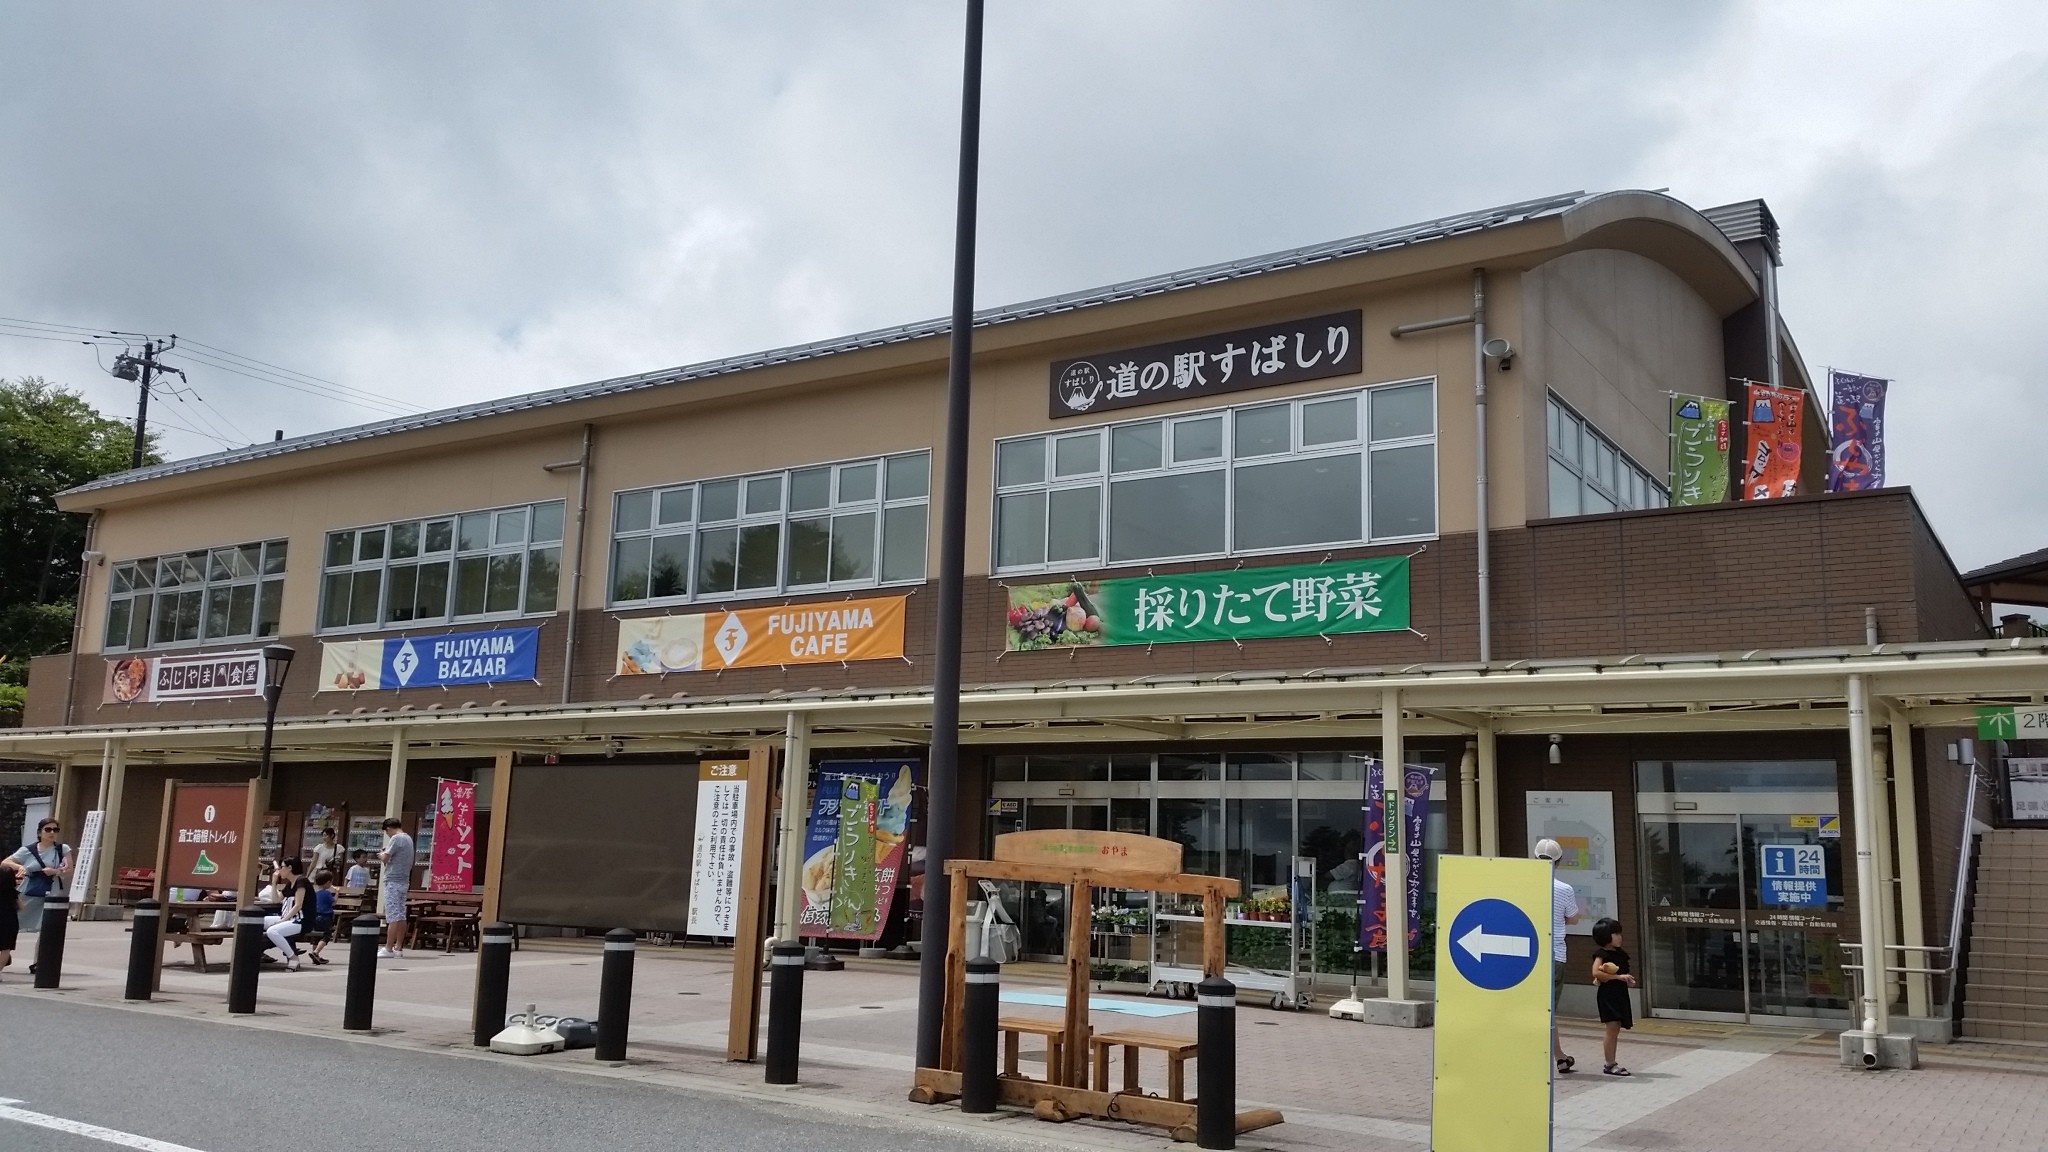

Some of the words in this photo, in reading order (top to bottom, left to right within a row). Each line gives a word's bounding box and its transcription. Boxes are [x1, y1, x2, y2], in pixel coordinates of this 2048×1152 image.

[1070, 367, 1090, 376] 道の駅
[1106, 326, 1351, 401] 道の駅すばしり
[1064, 375, 1095, 388] すばしり
[1134, 572, 1382, 631] 採りたて野菜
[767, 607, 875, 635] FUJIYAMA
[434, 635, 515, 660] FUJIYAMA
[790, 635, 848, 657] CAFE
[159, 664, 257, 687] ふじやま食堂
[438, 657, 507, 680] BAZAAR
[710, 764, 737, 777] ご注意
[1388, 801, 1396, 838] ドッグラン
[178, 829, 238, 844] 富士箱根トレイル
[456, 826, 473, 874] ソフト
[1101, 845, 1128, 857] おやま
[1798, 849, 1821, 864] 24
[1799, 864, 1821, 875] 時間
[1771, 880, 1817, 892] 情報提供
[1777, 891, 1812, 903] 実施中
